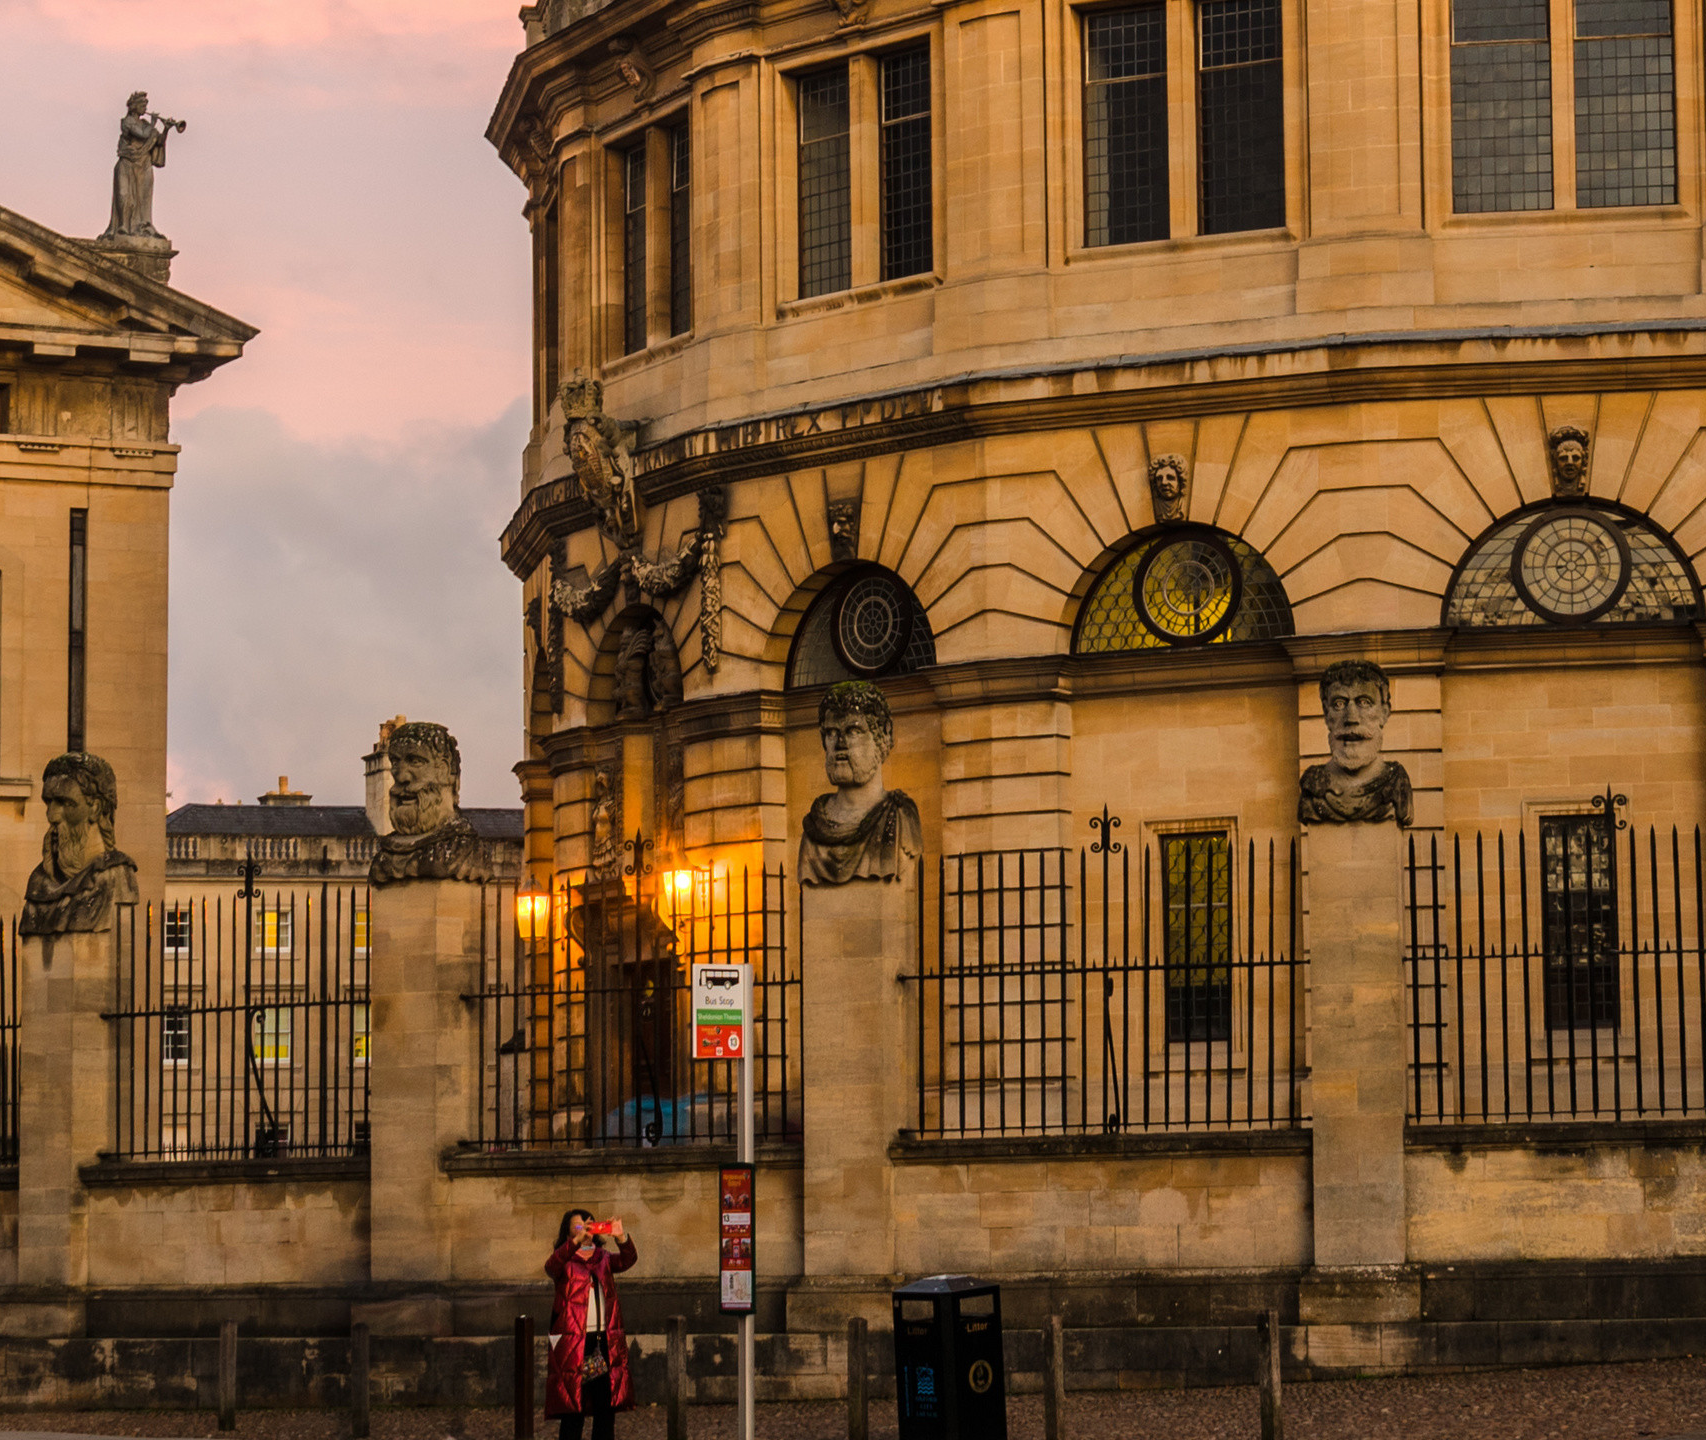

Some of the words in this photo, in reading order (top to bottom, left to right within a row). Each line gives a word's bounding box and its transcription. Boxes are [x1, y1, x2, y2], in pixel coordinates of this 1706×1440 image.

[776, 414, 822, 439] REX
[705, 996, 717, 1005] Bus
[719, 996, 734, 1007] Stop
[730, 1037, 737, 1047] 13
[724, 1214, 730, 1222] 13
[966, 1322, 988, 1333] Litter
